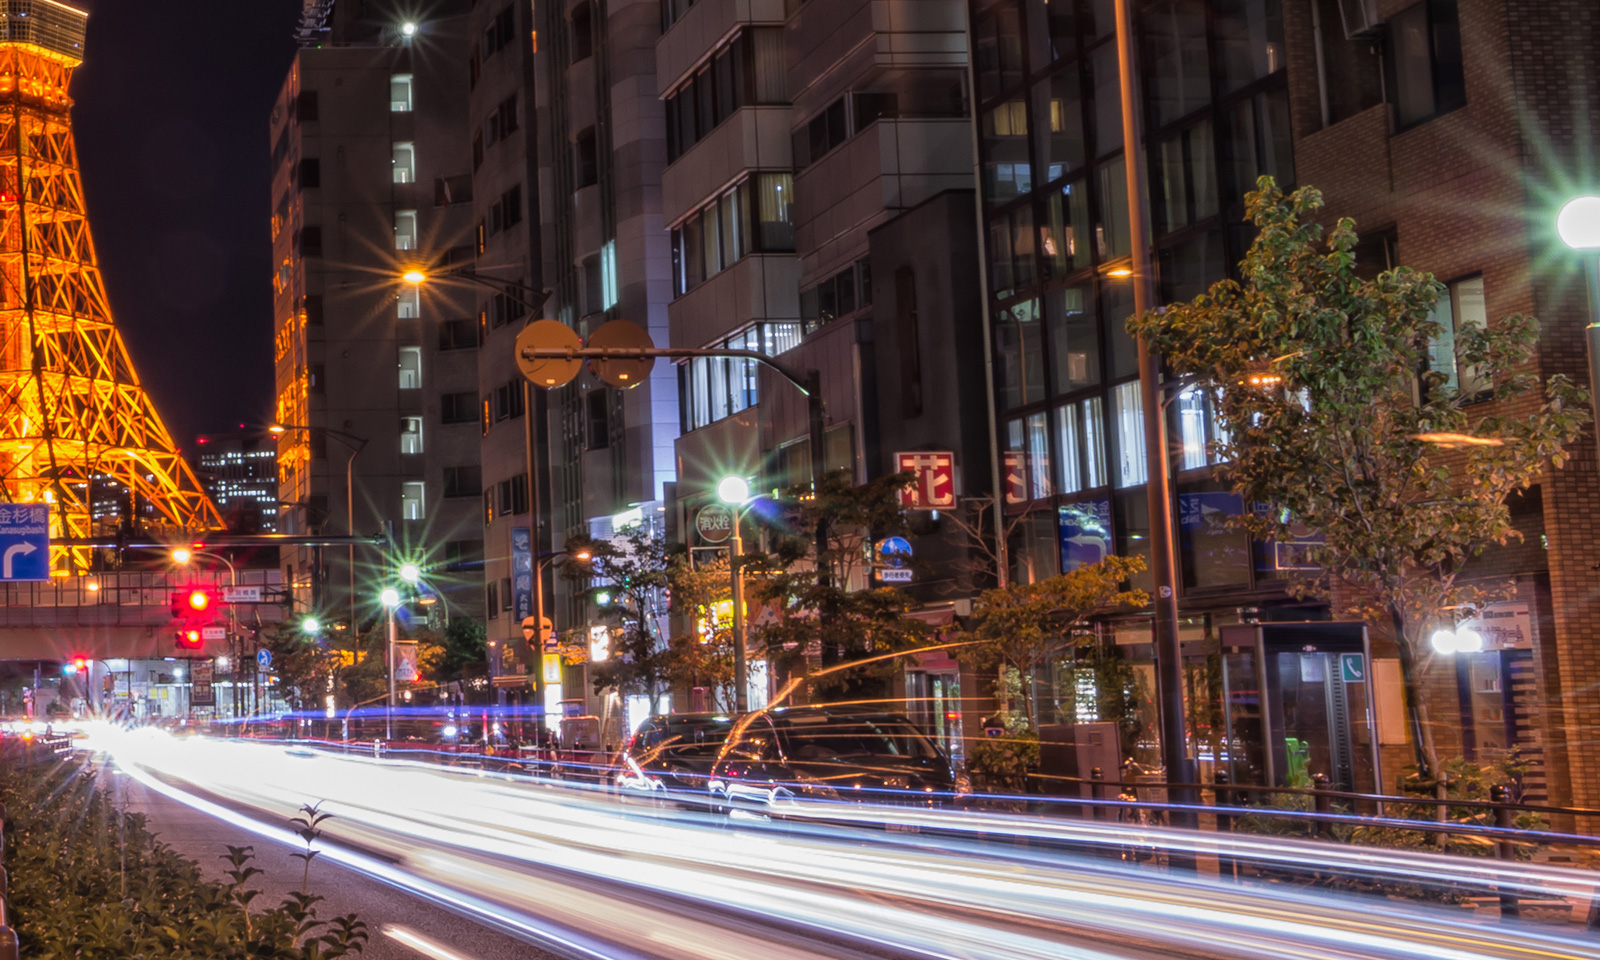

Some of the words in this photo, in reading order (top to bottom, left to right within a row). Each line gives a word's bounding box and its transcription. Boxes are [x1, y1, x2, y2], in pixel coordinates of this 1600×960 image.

[902, 455, 953, 506] 花
[700, 515, 731, 531] 消火栓
